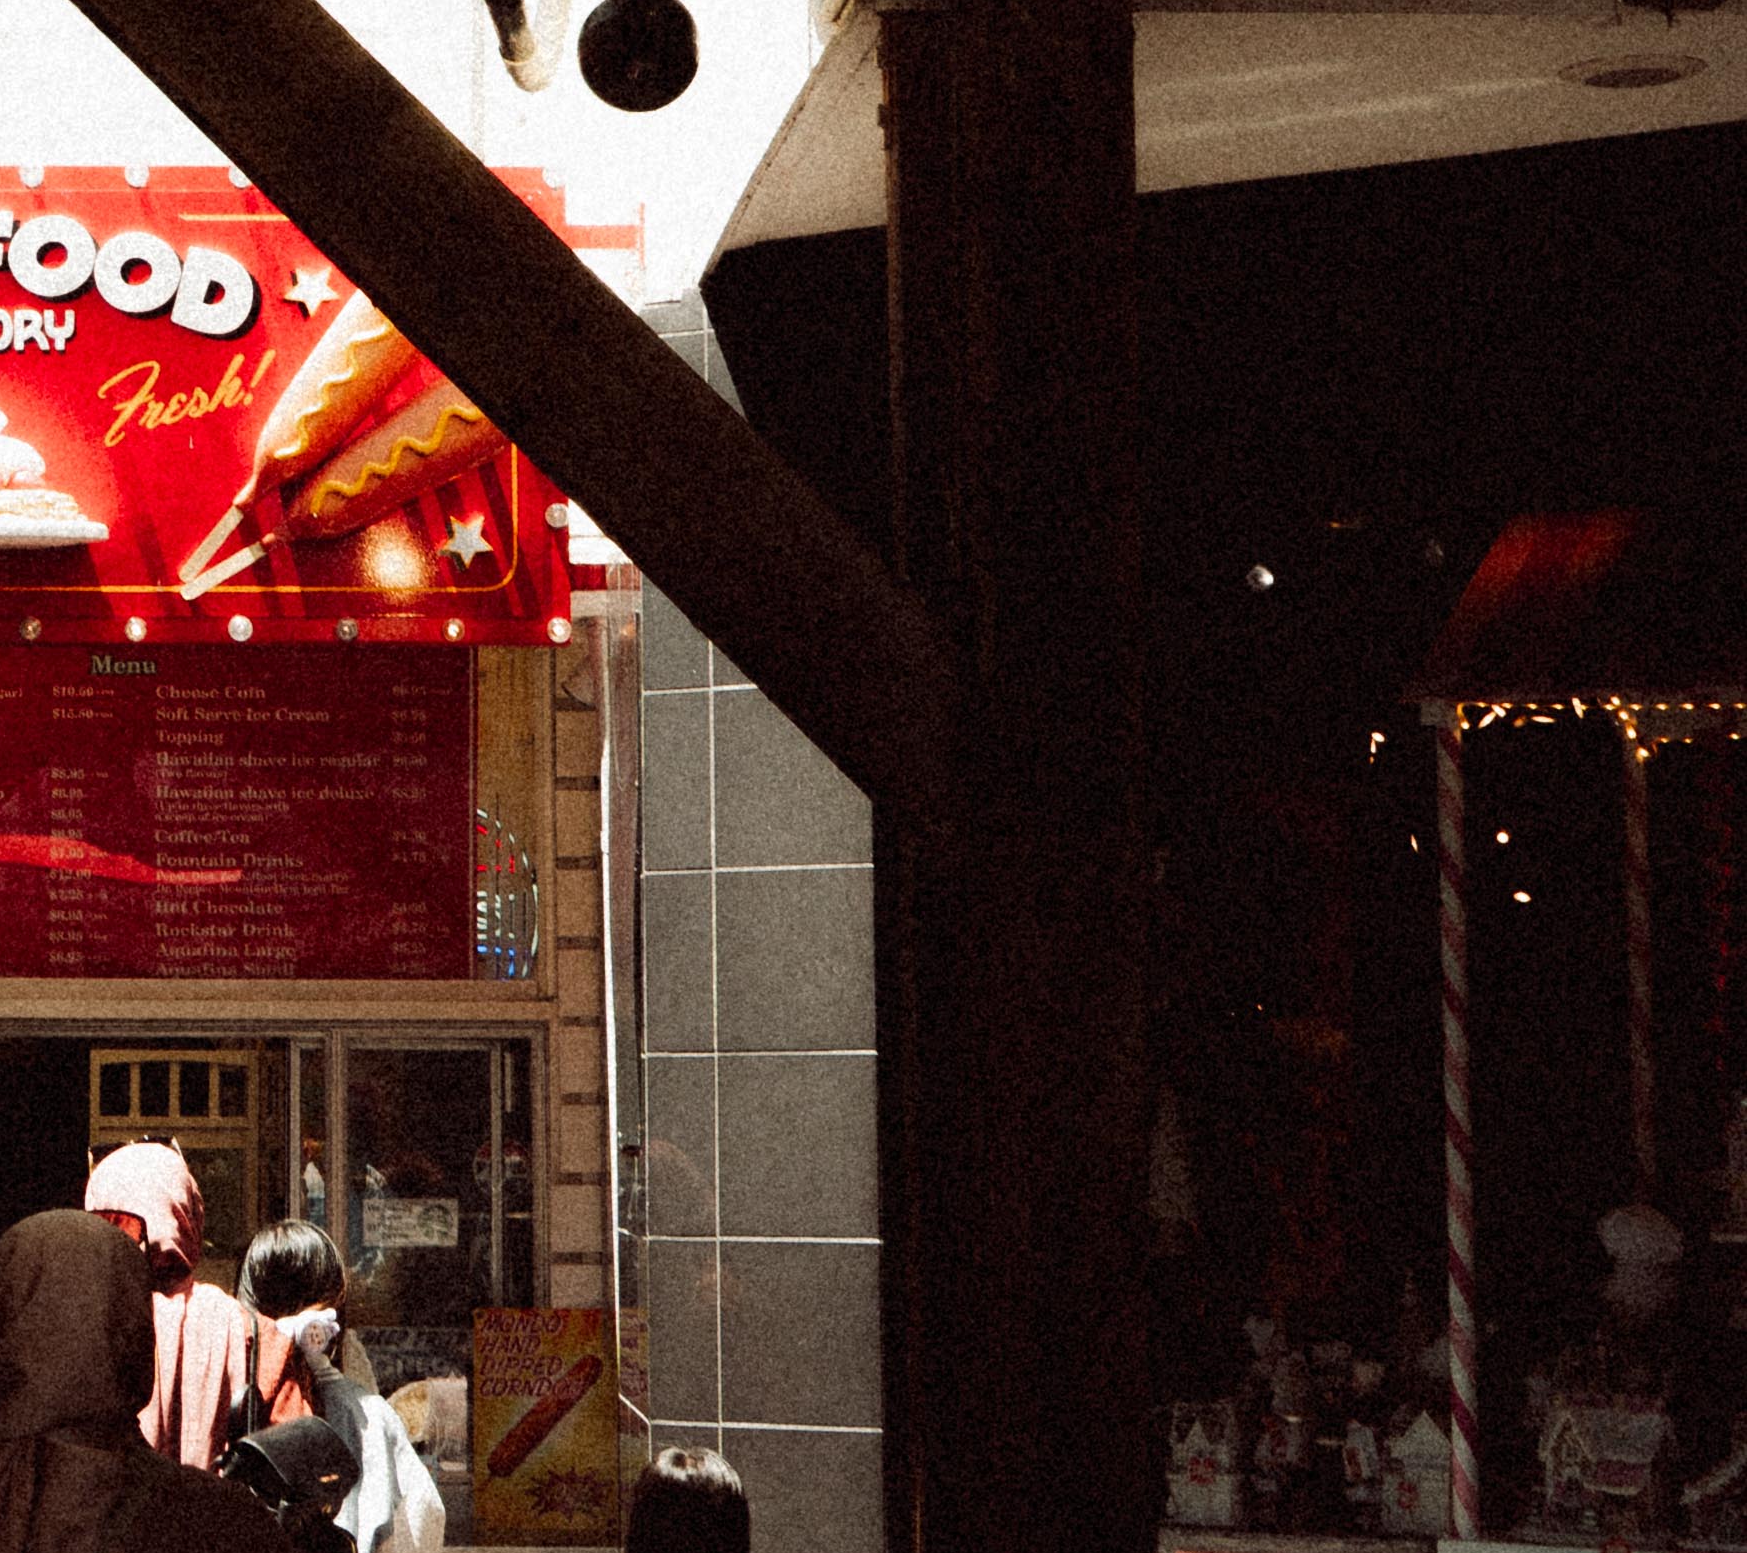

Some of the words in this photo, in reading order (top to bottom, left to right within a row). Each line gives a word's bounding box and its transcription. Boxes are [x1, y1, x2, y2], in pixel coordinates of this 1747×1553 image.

[98, 349, 276, 447] Fresh!
[91, 655, 157, 676] Menu
[155, 686, 219, 699] Cheese
[155, 708, 189, 722] Soft
[194, 708, 240, 722] Serve
[275, 708, 330, 722] Cream
[157, 730, 224, 747] Topping
[239, 752, 287, 767] shave
[239, 785, 286, 800] shave
[156, 853, 237, 868] Fountain
[243, 853, 303, 868] Drinks
[155, 901, 189, 915] Hot
[193, 901, 284, 915] Chocolate
[155, 923, 236, 938] Rockstar
[243, 923, 296, 938] Drink
[480, 1335, 541, 1354] HAND
[480, 1355, 563, 1376] DIPPED
